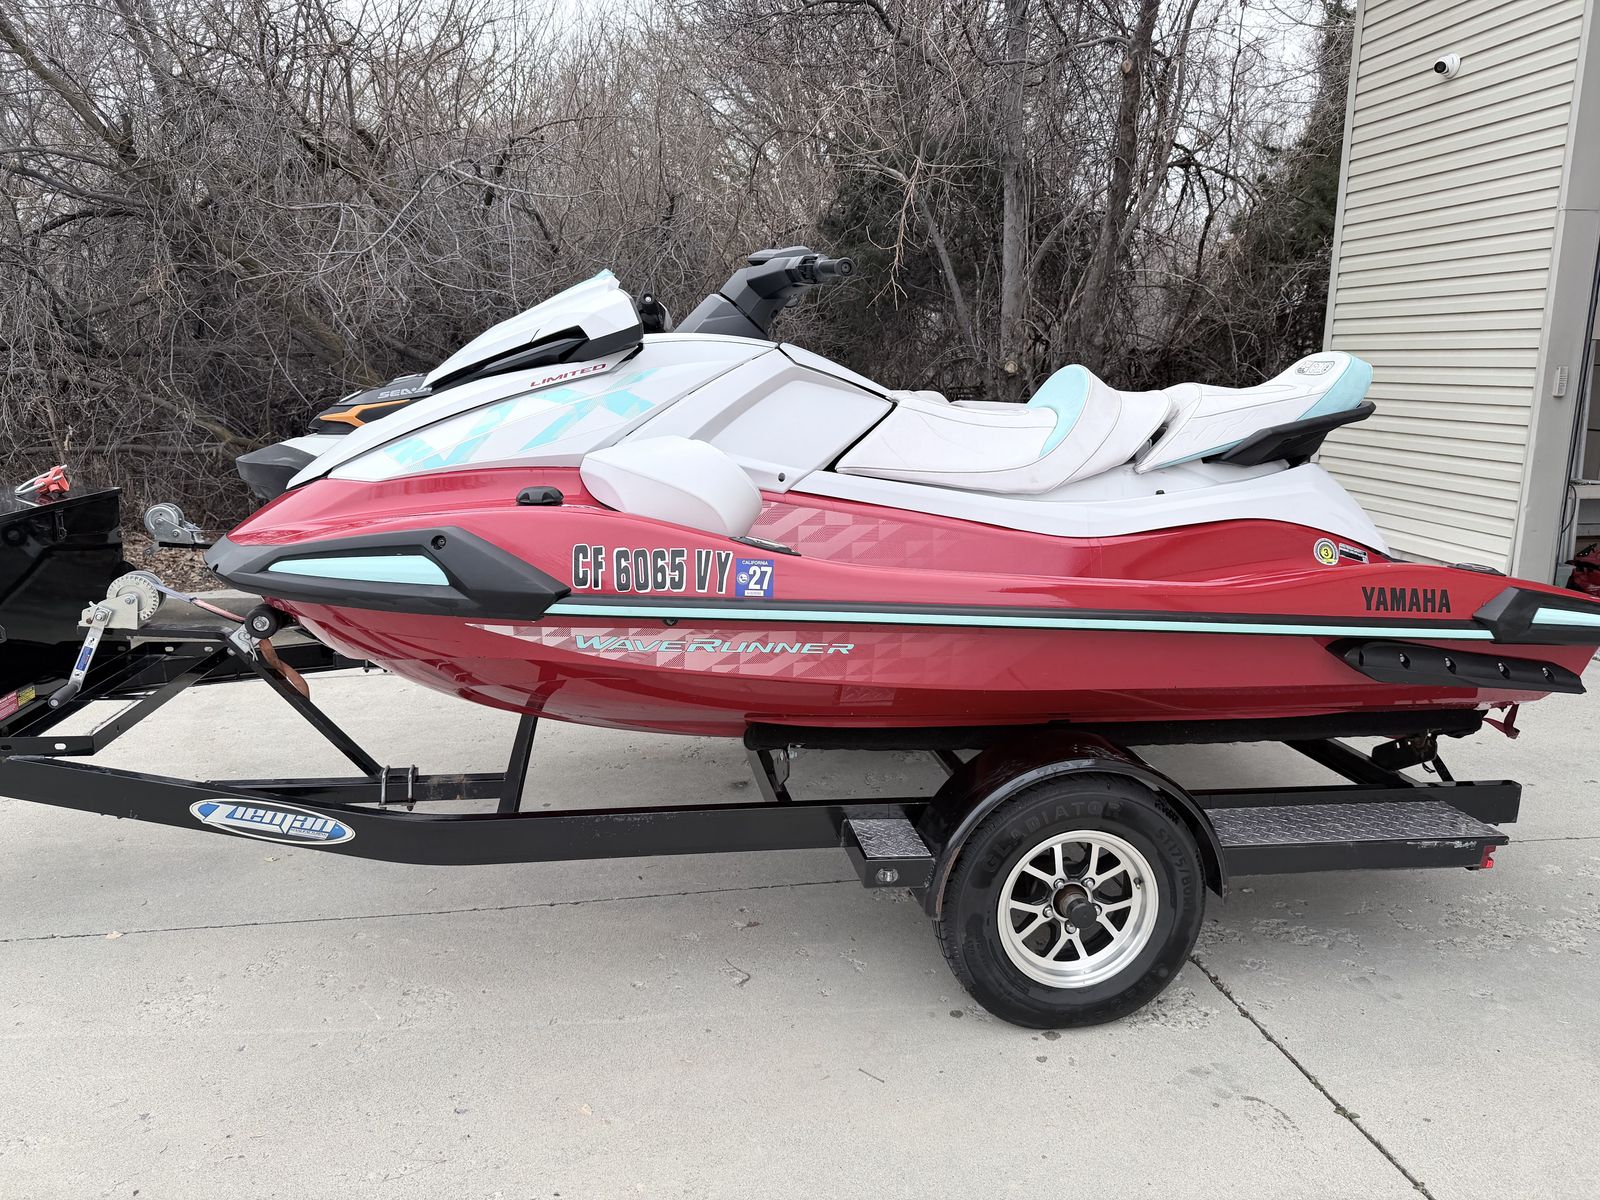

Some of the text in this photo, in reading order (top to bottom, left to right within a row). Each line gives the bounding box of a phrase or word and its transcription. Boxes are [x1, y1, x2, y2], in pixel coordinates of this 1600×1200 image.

[530, 363, 607, 387] LIMITED
[572, 543, 733, 594] CF 6065 VY
[748, 565, 772, 590] 27
[1361, 586, 1451, 613] YAMAHA
[983, 800, 1124, 873] GLADIATOR
